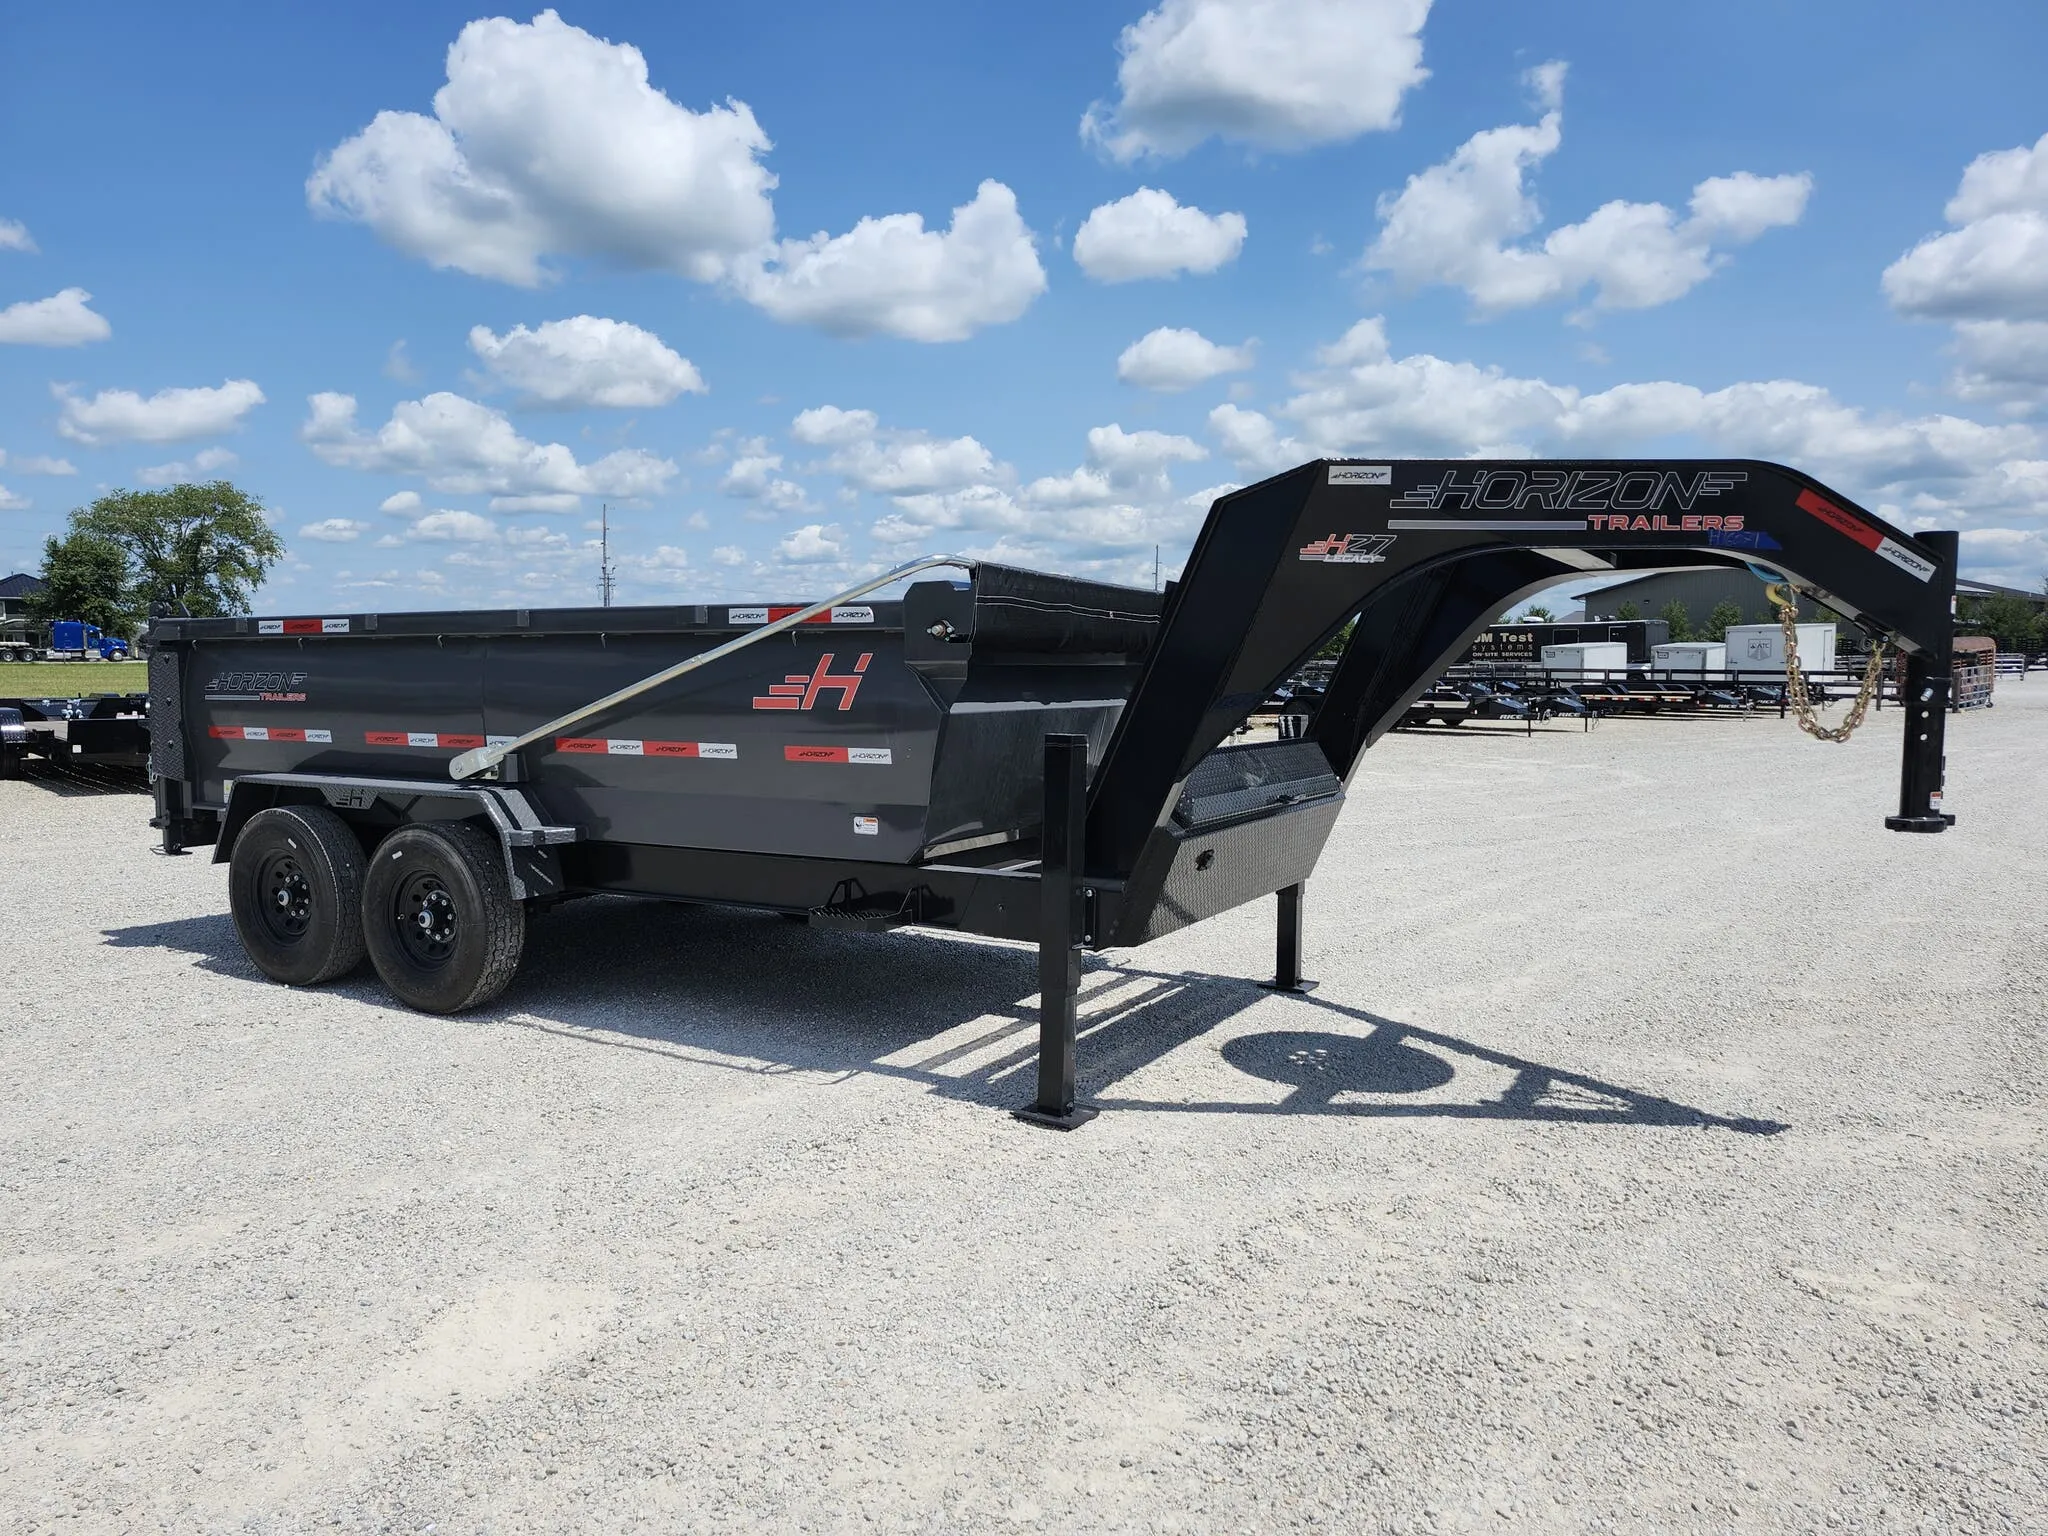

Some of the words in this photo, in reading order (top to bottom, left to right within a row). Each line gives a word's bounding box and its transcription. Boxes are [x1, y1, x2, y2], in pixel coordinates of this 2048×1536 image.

[1427, 471, 1712, 510] HORIZON
[1588, 514, 1745, 532] TRAILERS
[1322, 533, 1398, 556] H27
[1323, 554, 1380, 563] LEGACY
[1884, 547, 1929, 572] HORIZON
[1500, 632, 1533, 642] Test
[214, 672, 298, 690] HORIZON
[260, 692, 307, 701] TRAILERS
